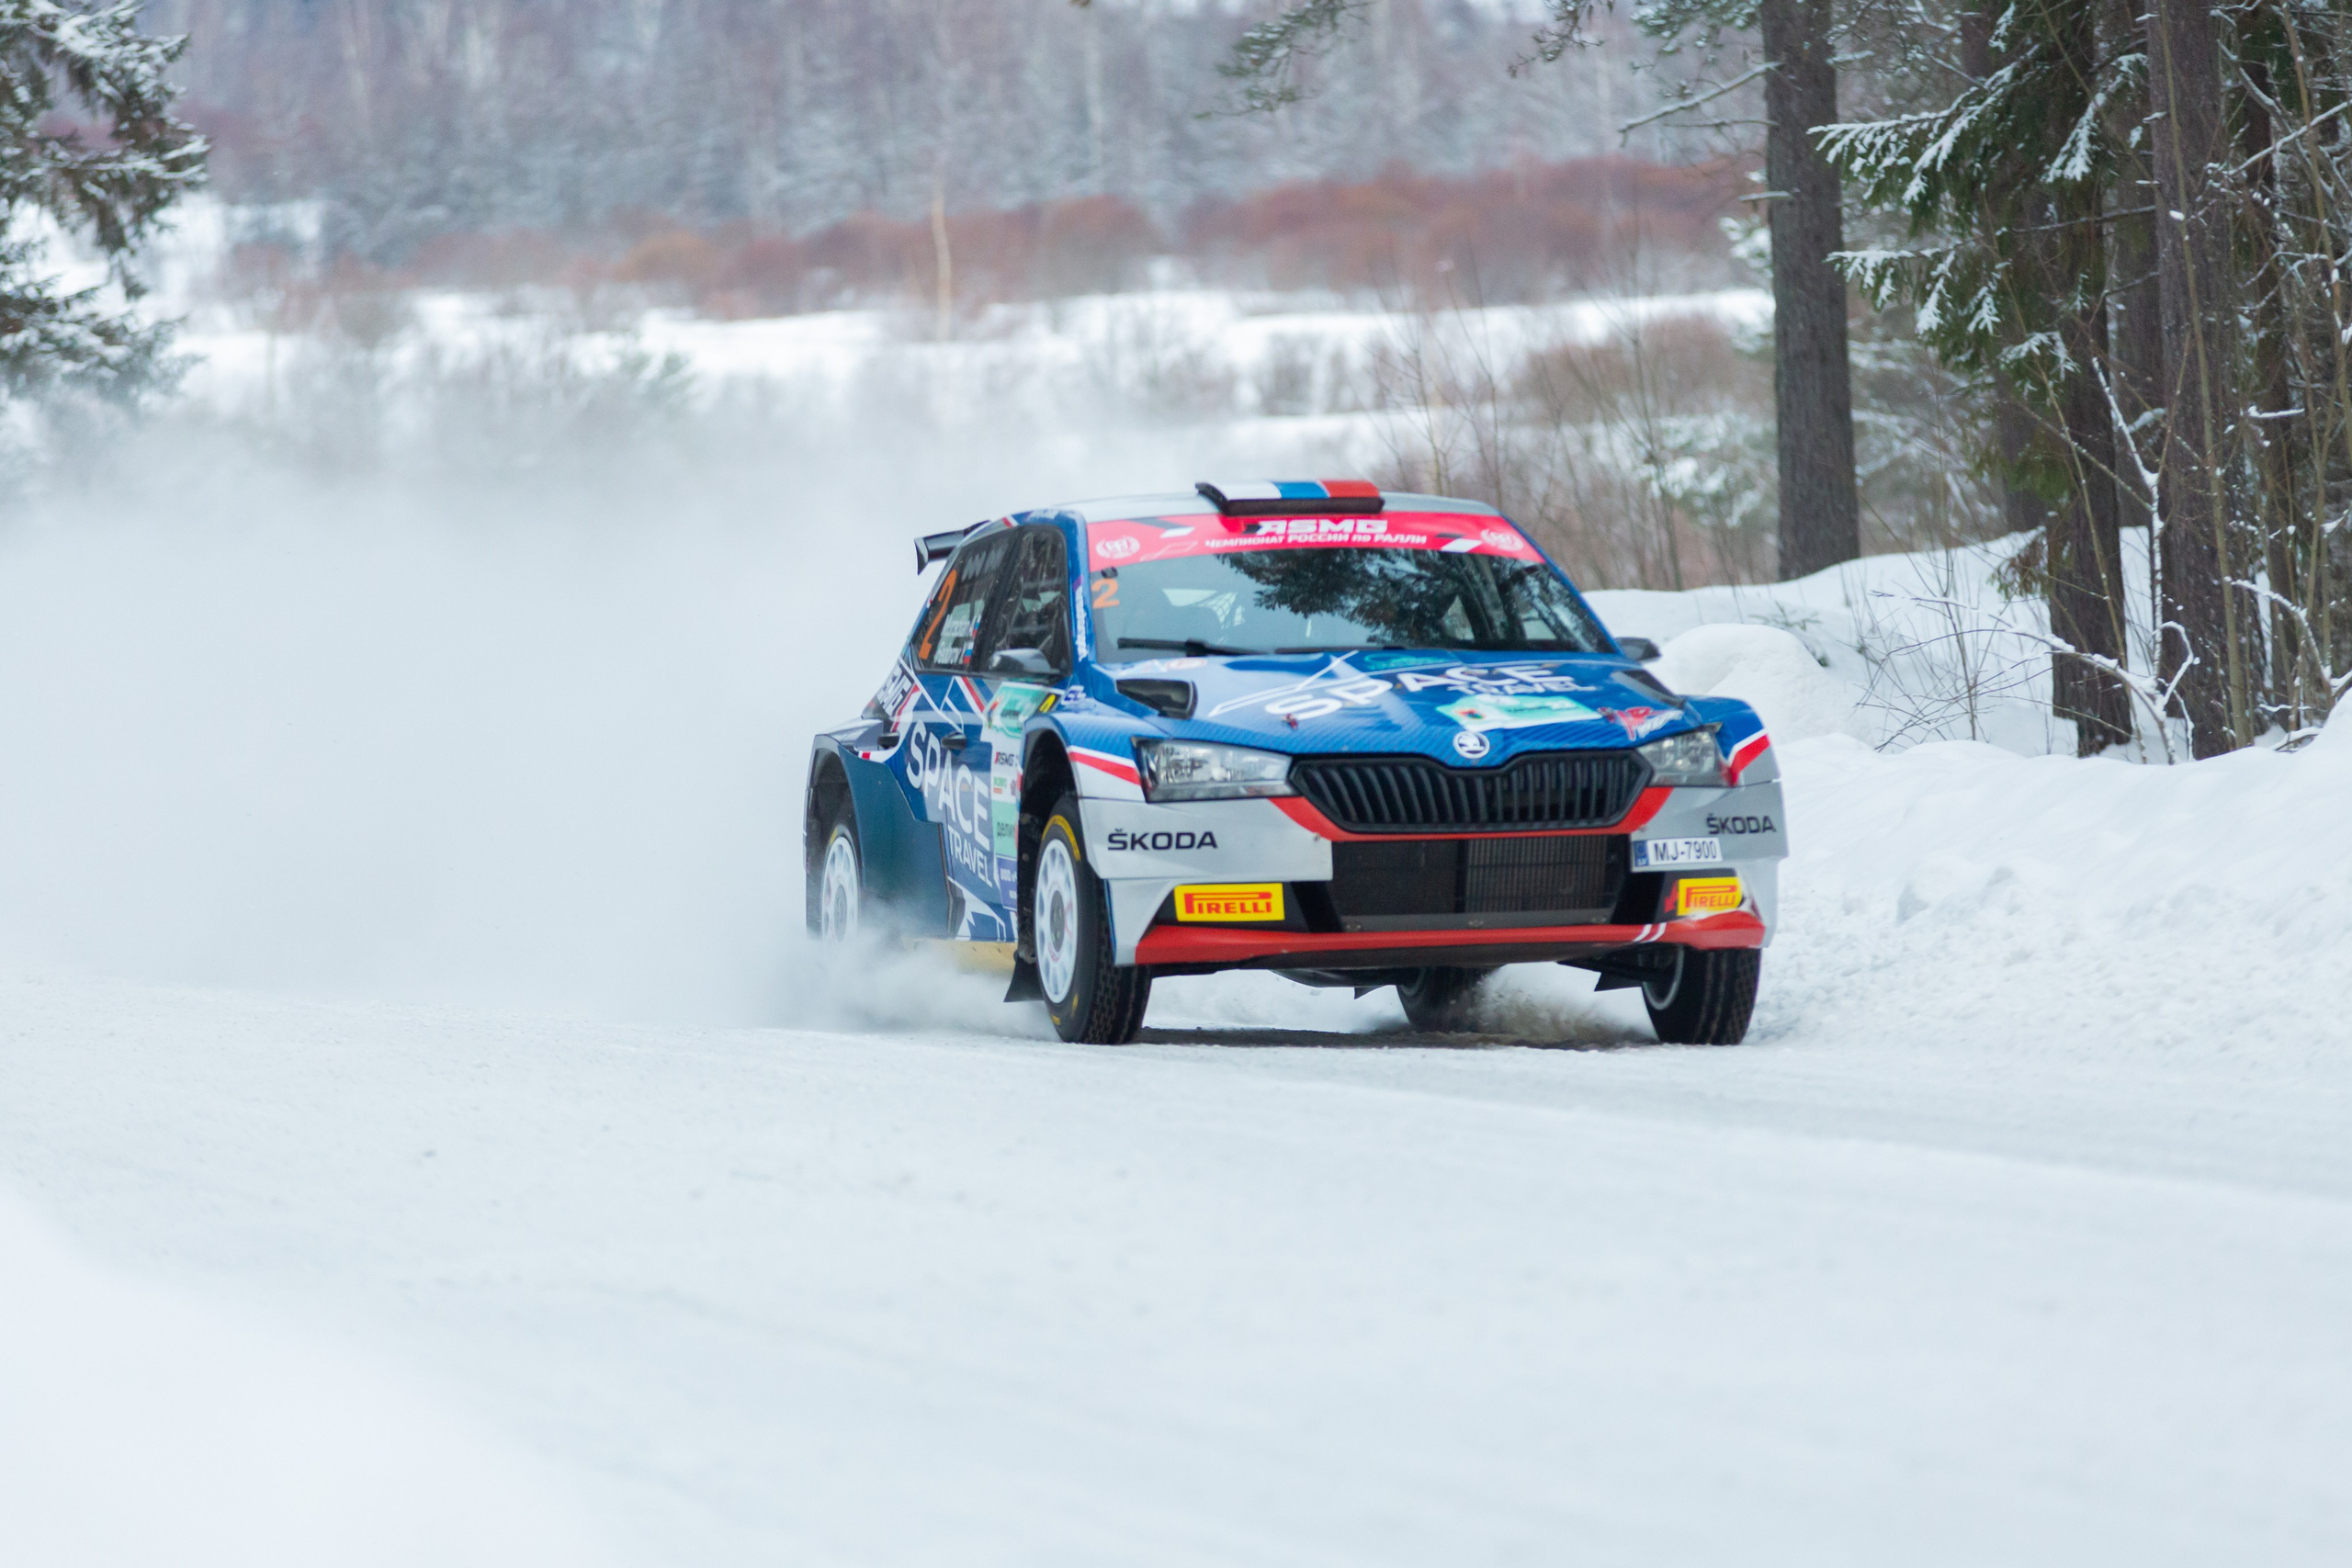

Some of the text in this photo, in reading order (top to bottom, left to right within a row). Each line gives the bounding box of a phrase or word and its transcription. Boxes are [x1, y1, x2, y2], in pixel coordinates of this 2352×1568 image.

[1205, 534, 1284, 548] ЧЕМПИОНАТ
[1287, 533, 1349, 544] РОССИИ
[1374, 533, 1427, 544] РАЛЛИ
[1091, 578, 1120, 609] 2
[919, 569, 956, 660] 2
[1264, 664, 1577, 721] SPACE
[906, 721, 990, 851] SPACE
[1706, 813, 1777, 835] ŠKODA
[1108, 829, 1218, 851] ŠKODA
[1654, 840, 1718, 862] MJ-7900
[947, 824, 993, 888] TRAVEL
[1183, 892, 1272, 914] PIRELLI
[1686, 885, 1737, 908] PIRELLI
